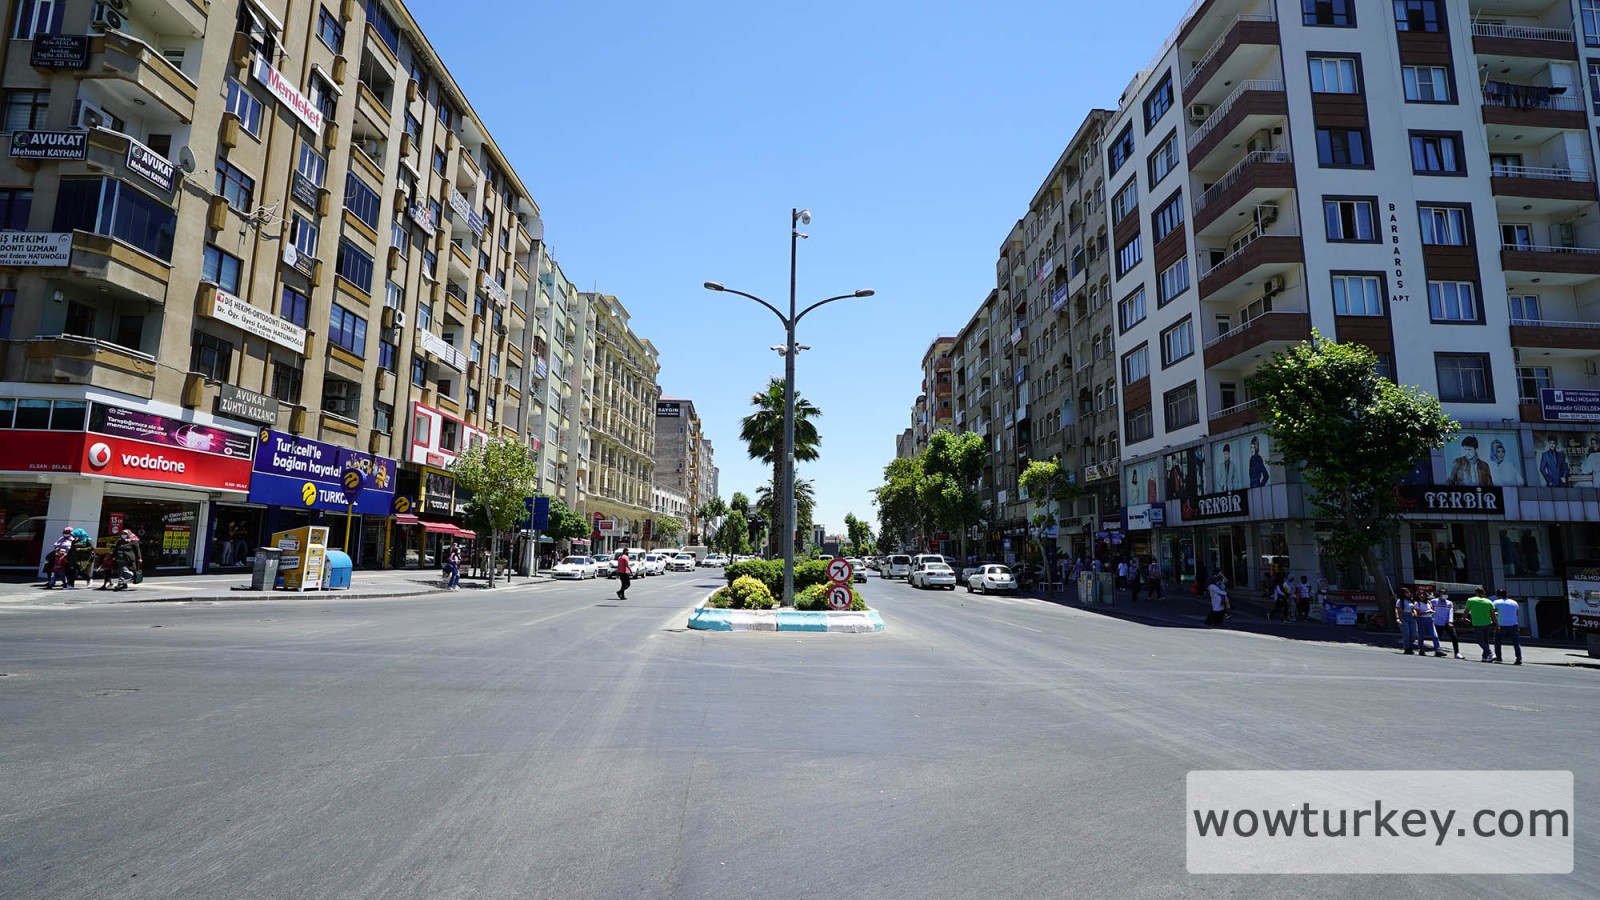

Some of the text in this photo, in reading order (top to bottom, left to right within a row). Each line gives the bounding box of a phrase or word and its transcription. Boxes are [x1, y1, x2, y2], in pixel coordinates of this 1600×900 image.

[268, 67, 320, 128] Memleket
[30, 133, 83, 146] AVUKAT
[12, 147, 82, 158] Mehmet KAYHAN
[141, 152, 174, 178] AVUKAT
[26, 245, 58, 253] UZMANI
[1388, 203, 1404, 289] BARBAROS
[217, 305, 226, 314] Dr.
[241, 313, 256, 325] Üyesi
[236, 389, 267, 407] AVUKAT
[222, 396, 277, 422] ZÜHTÜ KAZANCI
[106, 422, 136, 430] memnun
[276, 437, 322, 460] Turkcell'le
[121, 453, 186, 474] vodafone
[273, 453, 342, 478] bağlan hayata!
[319, 490, 358, 506] TURKC
[1424, 487, 1497, 509] TEKBİR
